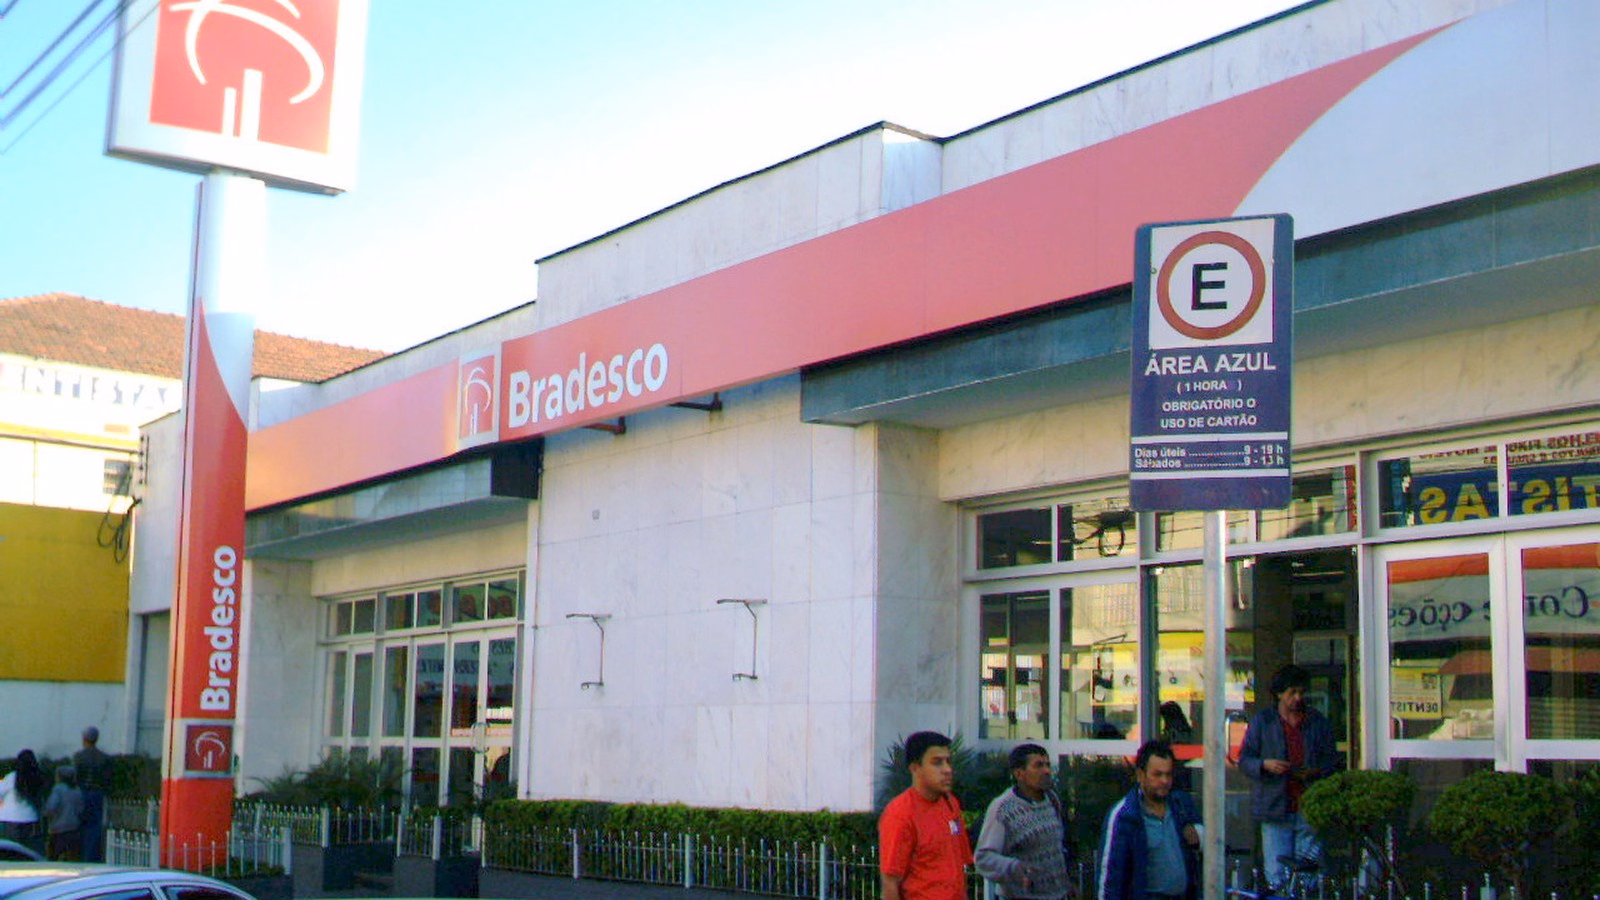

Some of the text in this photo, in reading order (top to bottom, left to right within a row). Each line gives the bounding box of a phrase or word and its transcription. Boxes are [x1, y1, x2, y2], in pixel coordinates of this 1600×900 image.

[1191, 262, 1228, 310] E
[1144, 351, 1277, 376] ÁREA AZUL
[508, 343, 669, 428] Bradesco
[1193, 380, 1228, 392] HORA
[1162, 397, 1257, 412] OBRIGATÓRIO O
[1160, 413, 1257, 428] USO DE CARTÃO
[1134, 447, 1158, 459] Dias
[1276, 444, 1284, 455] h
[1134, 457, 1182, 469] Sábados
[1276, 455, 1285, 466] h
[200, 545, 238, 712] Bradesco
